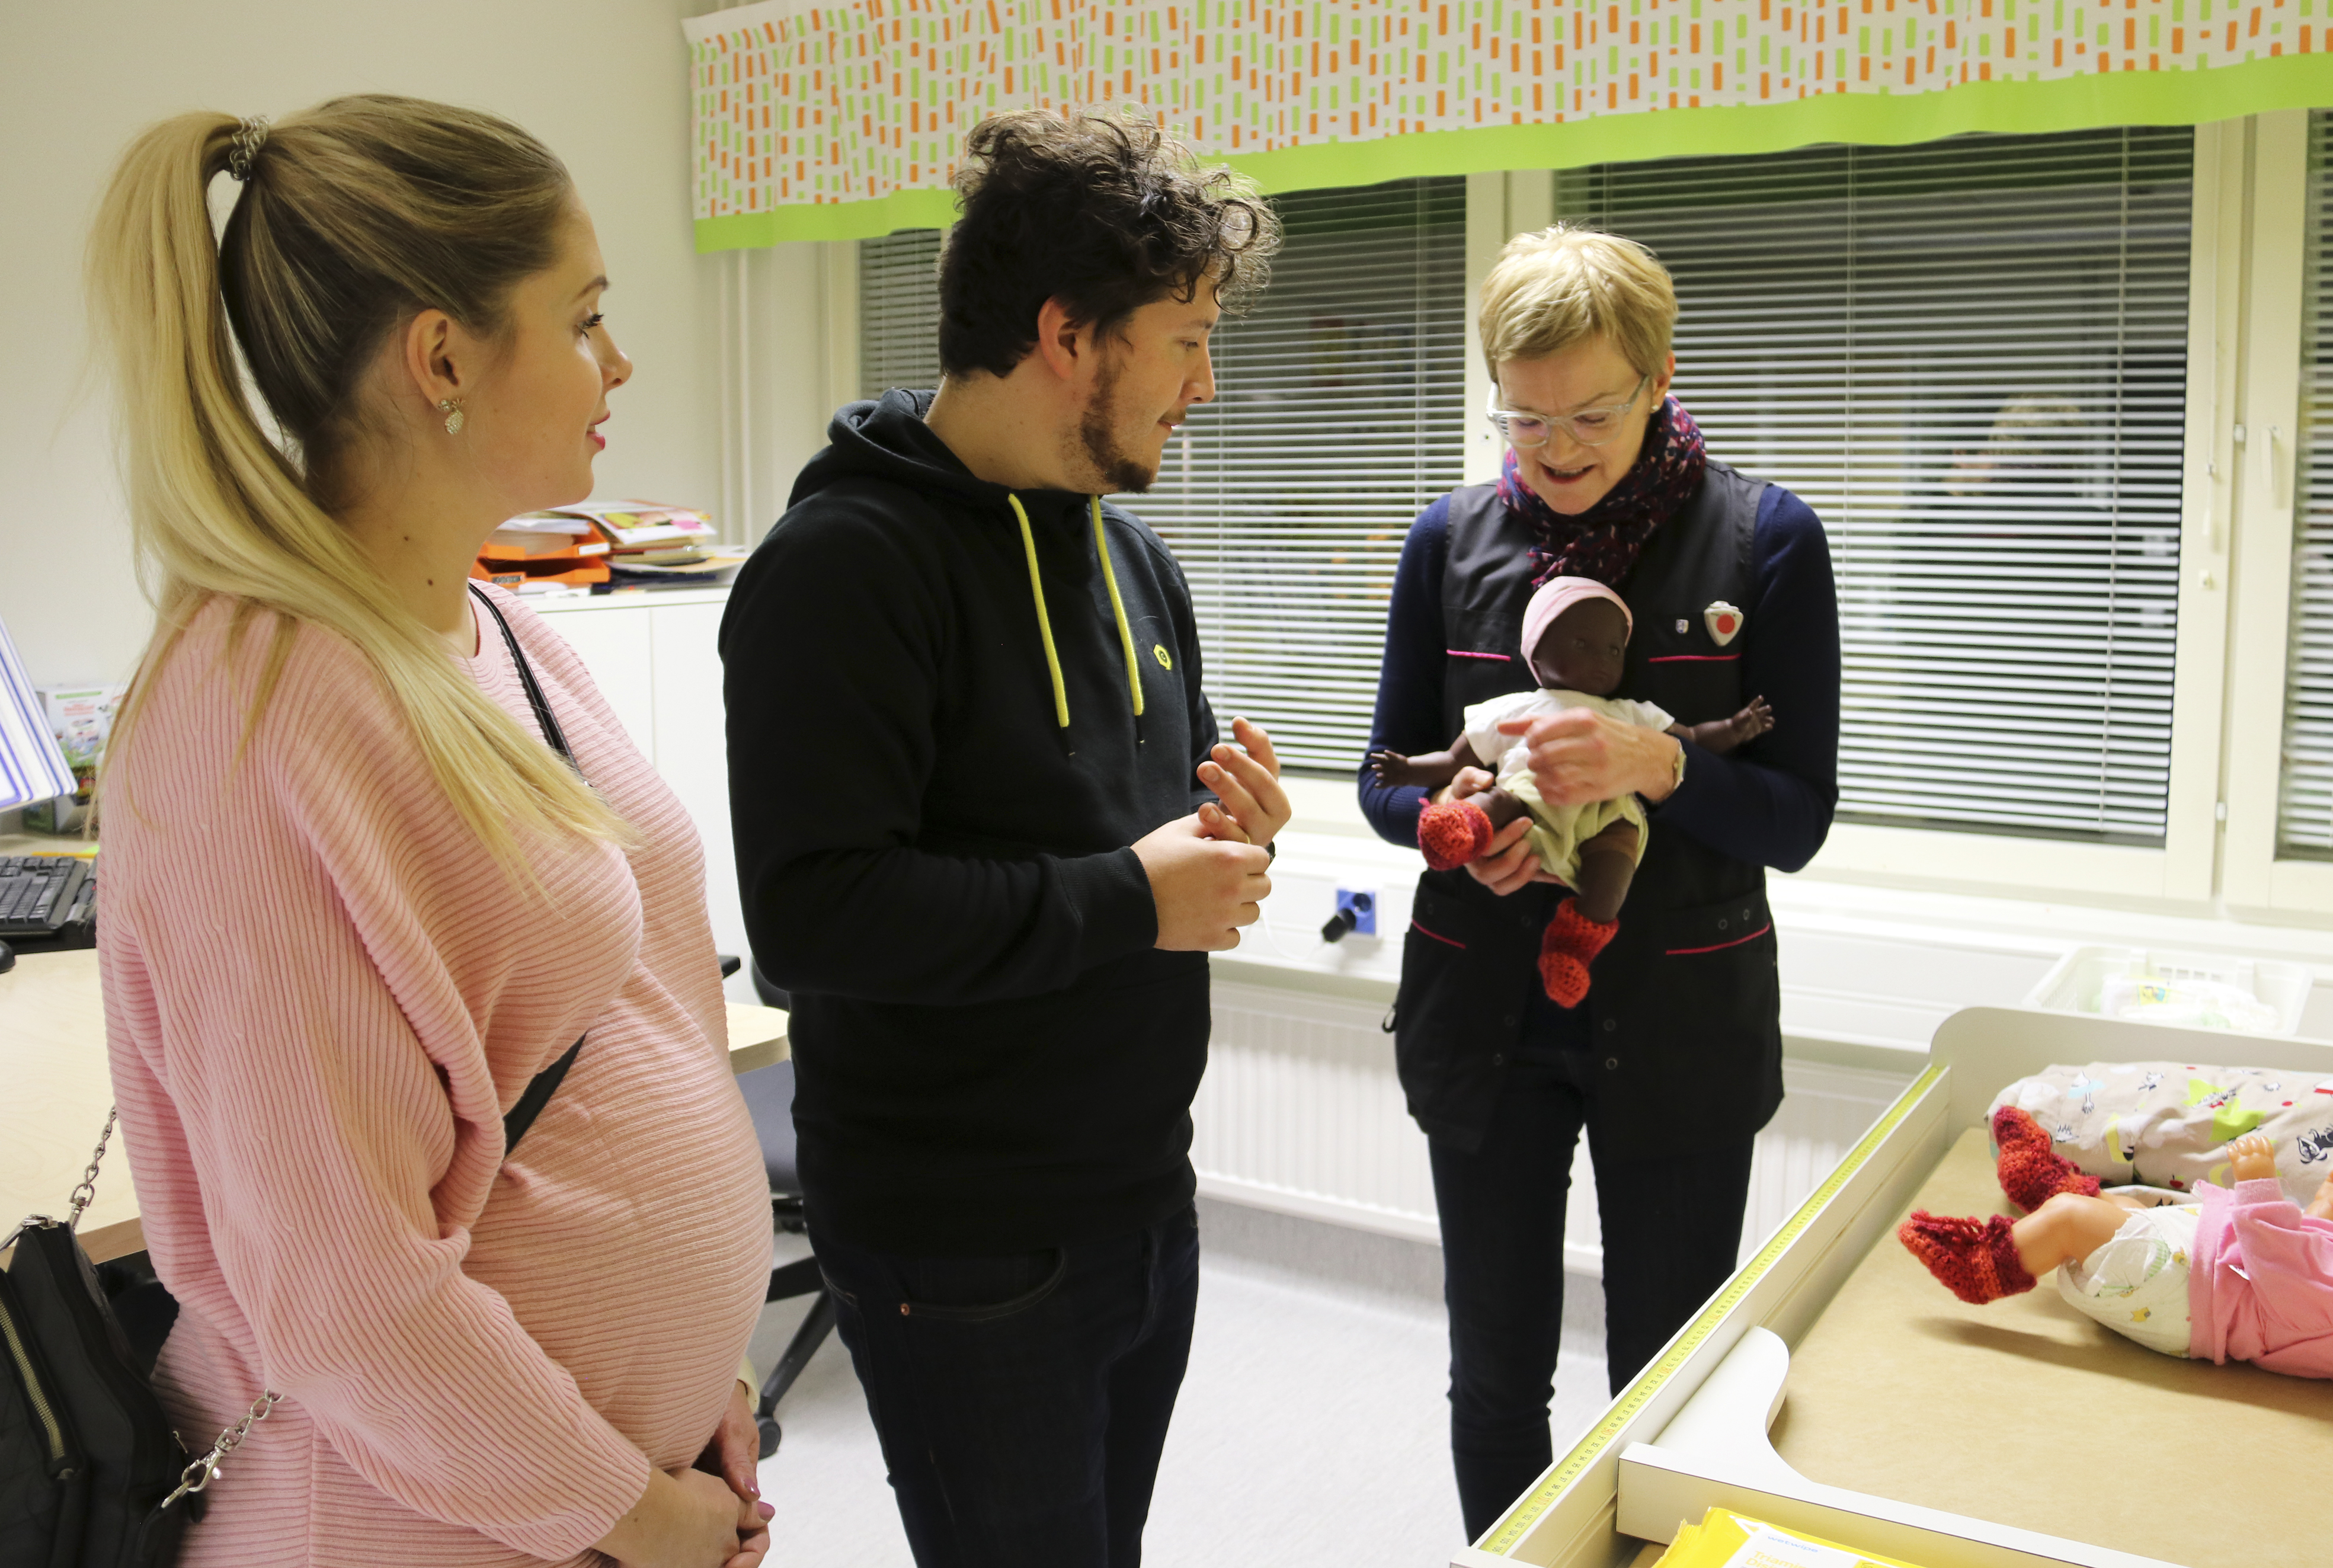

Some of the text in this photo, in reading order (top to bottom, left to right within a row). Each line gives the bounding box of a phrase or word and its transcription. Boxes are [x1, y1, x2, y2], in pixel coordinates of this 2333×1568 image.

[1601, 1427, 1615, 1435] 90
[1535, 1495, 1550, 1505] 100
[1768, 1536, 1818, 1552] wetwipe
